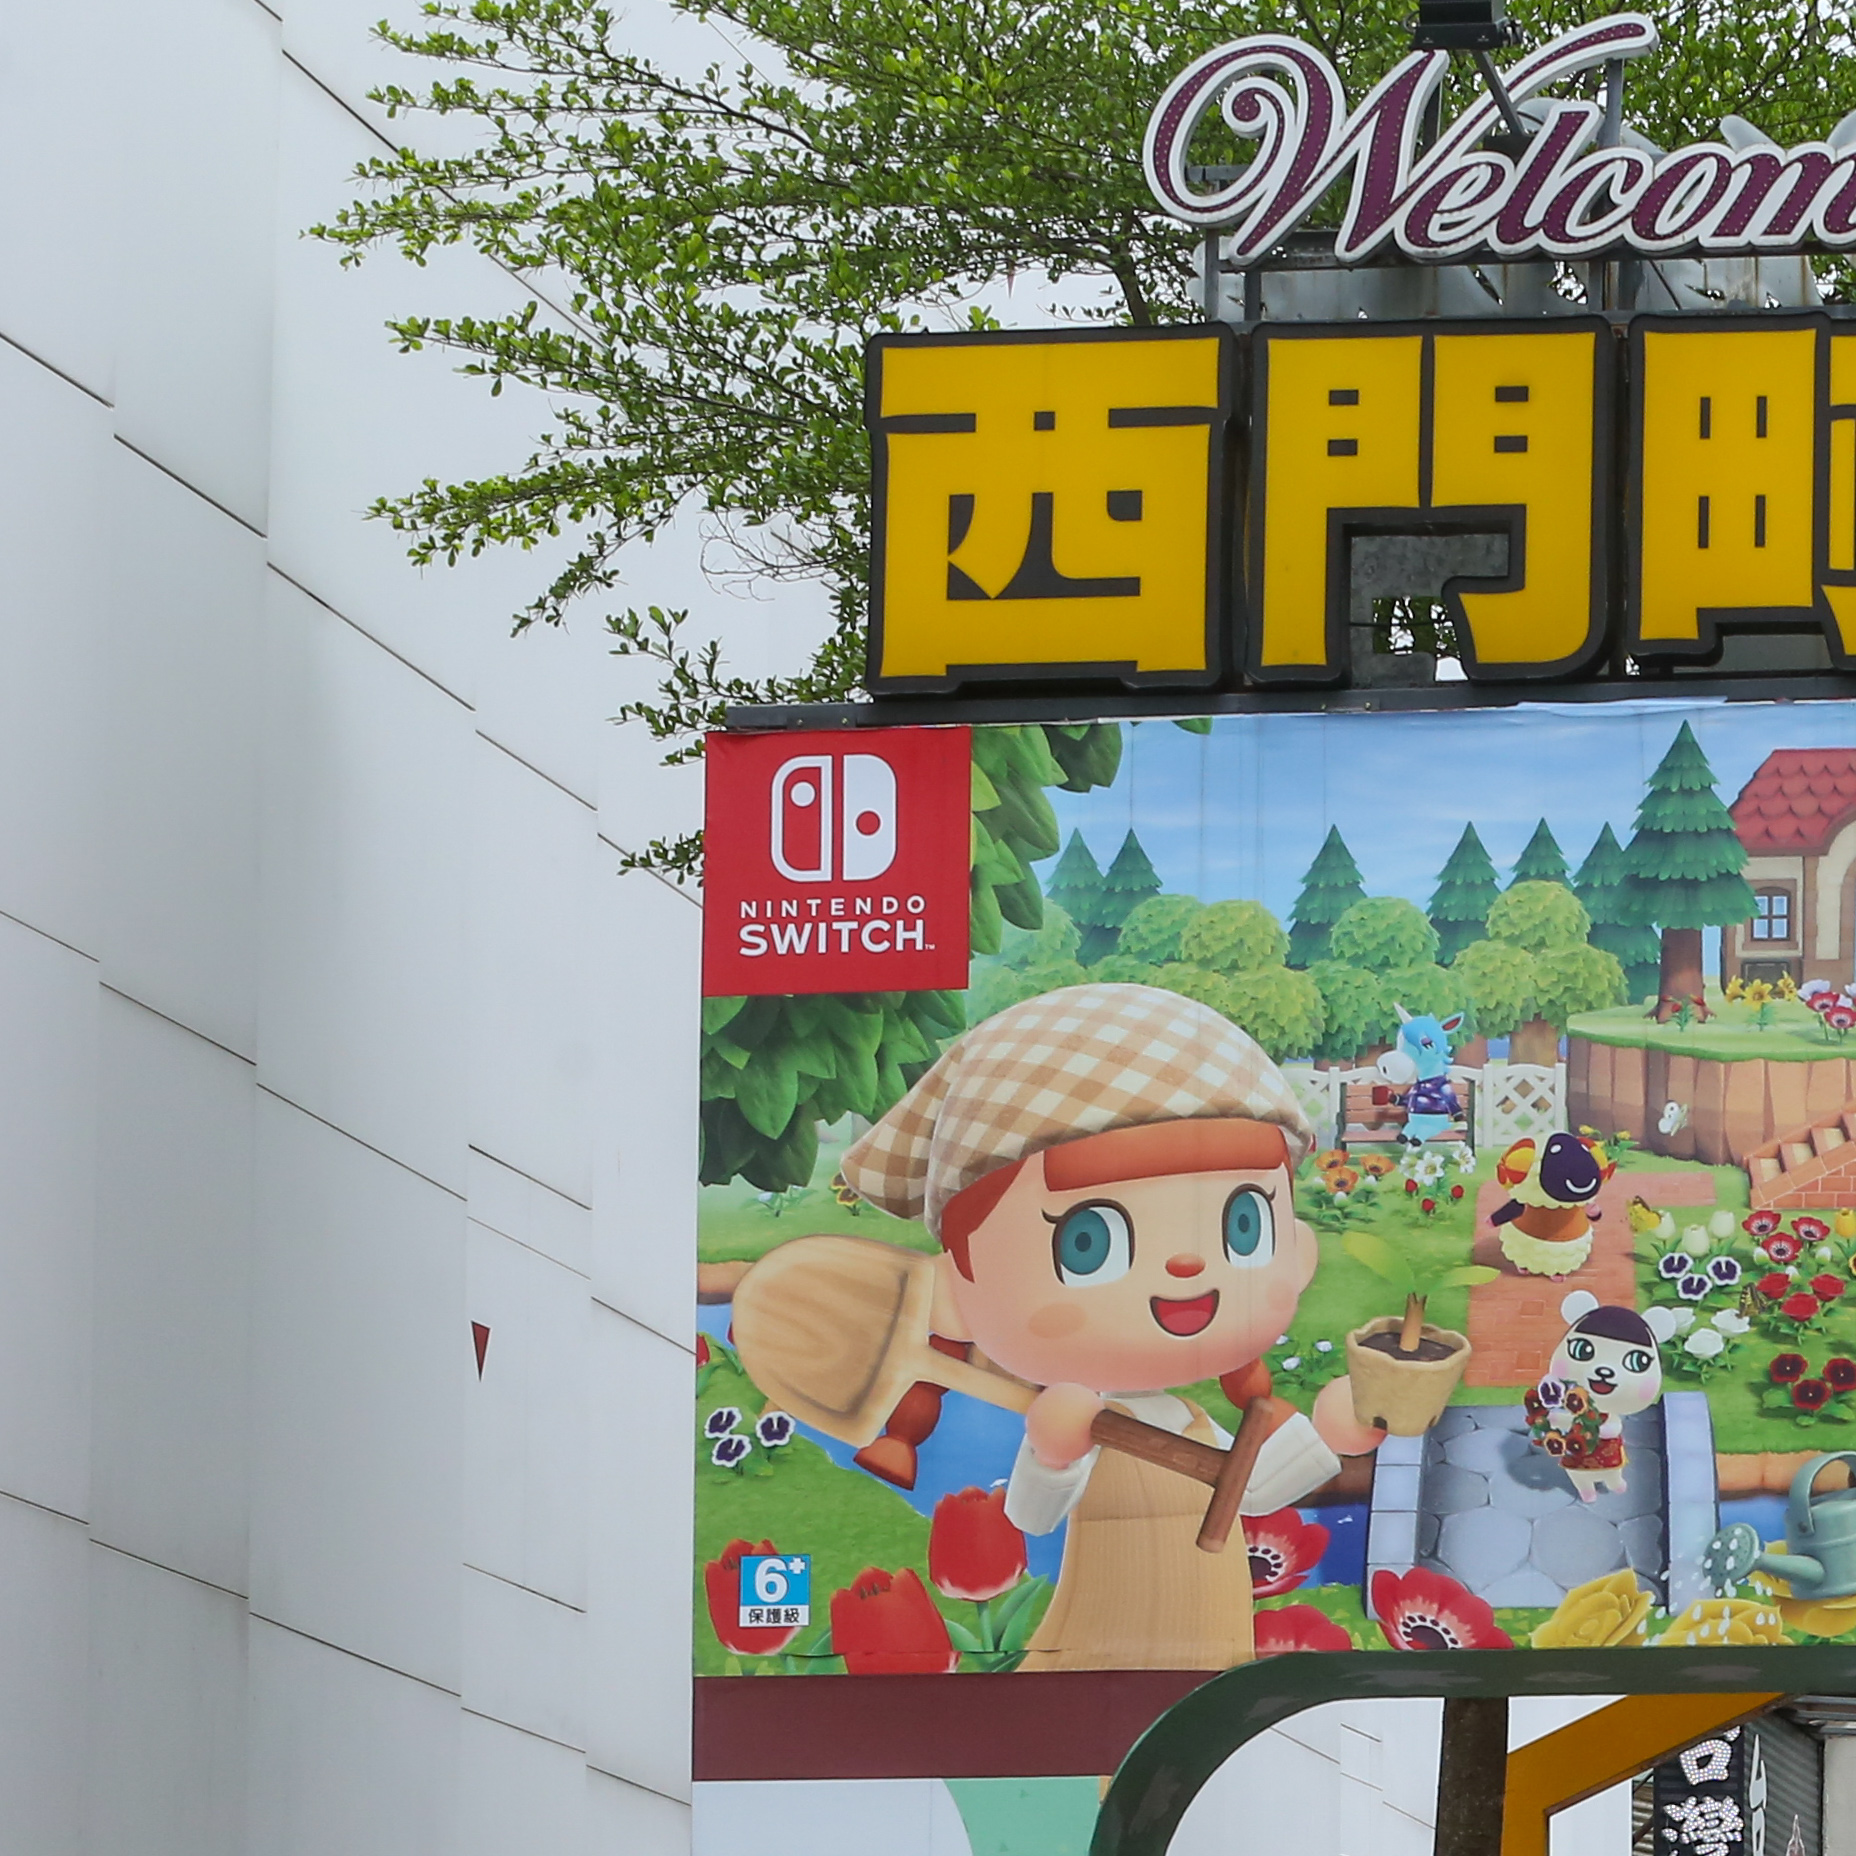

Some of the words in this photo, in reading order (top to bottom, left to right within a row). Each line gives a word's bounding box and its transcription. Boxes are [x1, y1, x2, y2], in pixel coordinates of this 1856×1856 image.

[740, 895, 926, 919] NINTENDO
[738, 918, 924, 957] SWITCH
[748, 1607, 800, 1625] 保護級
